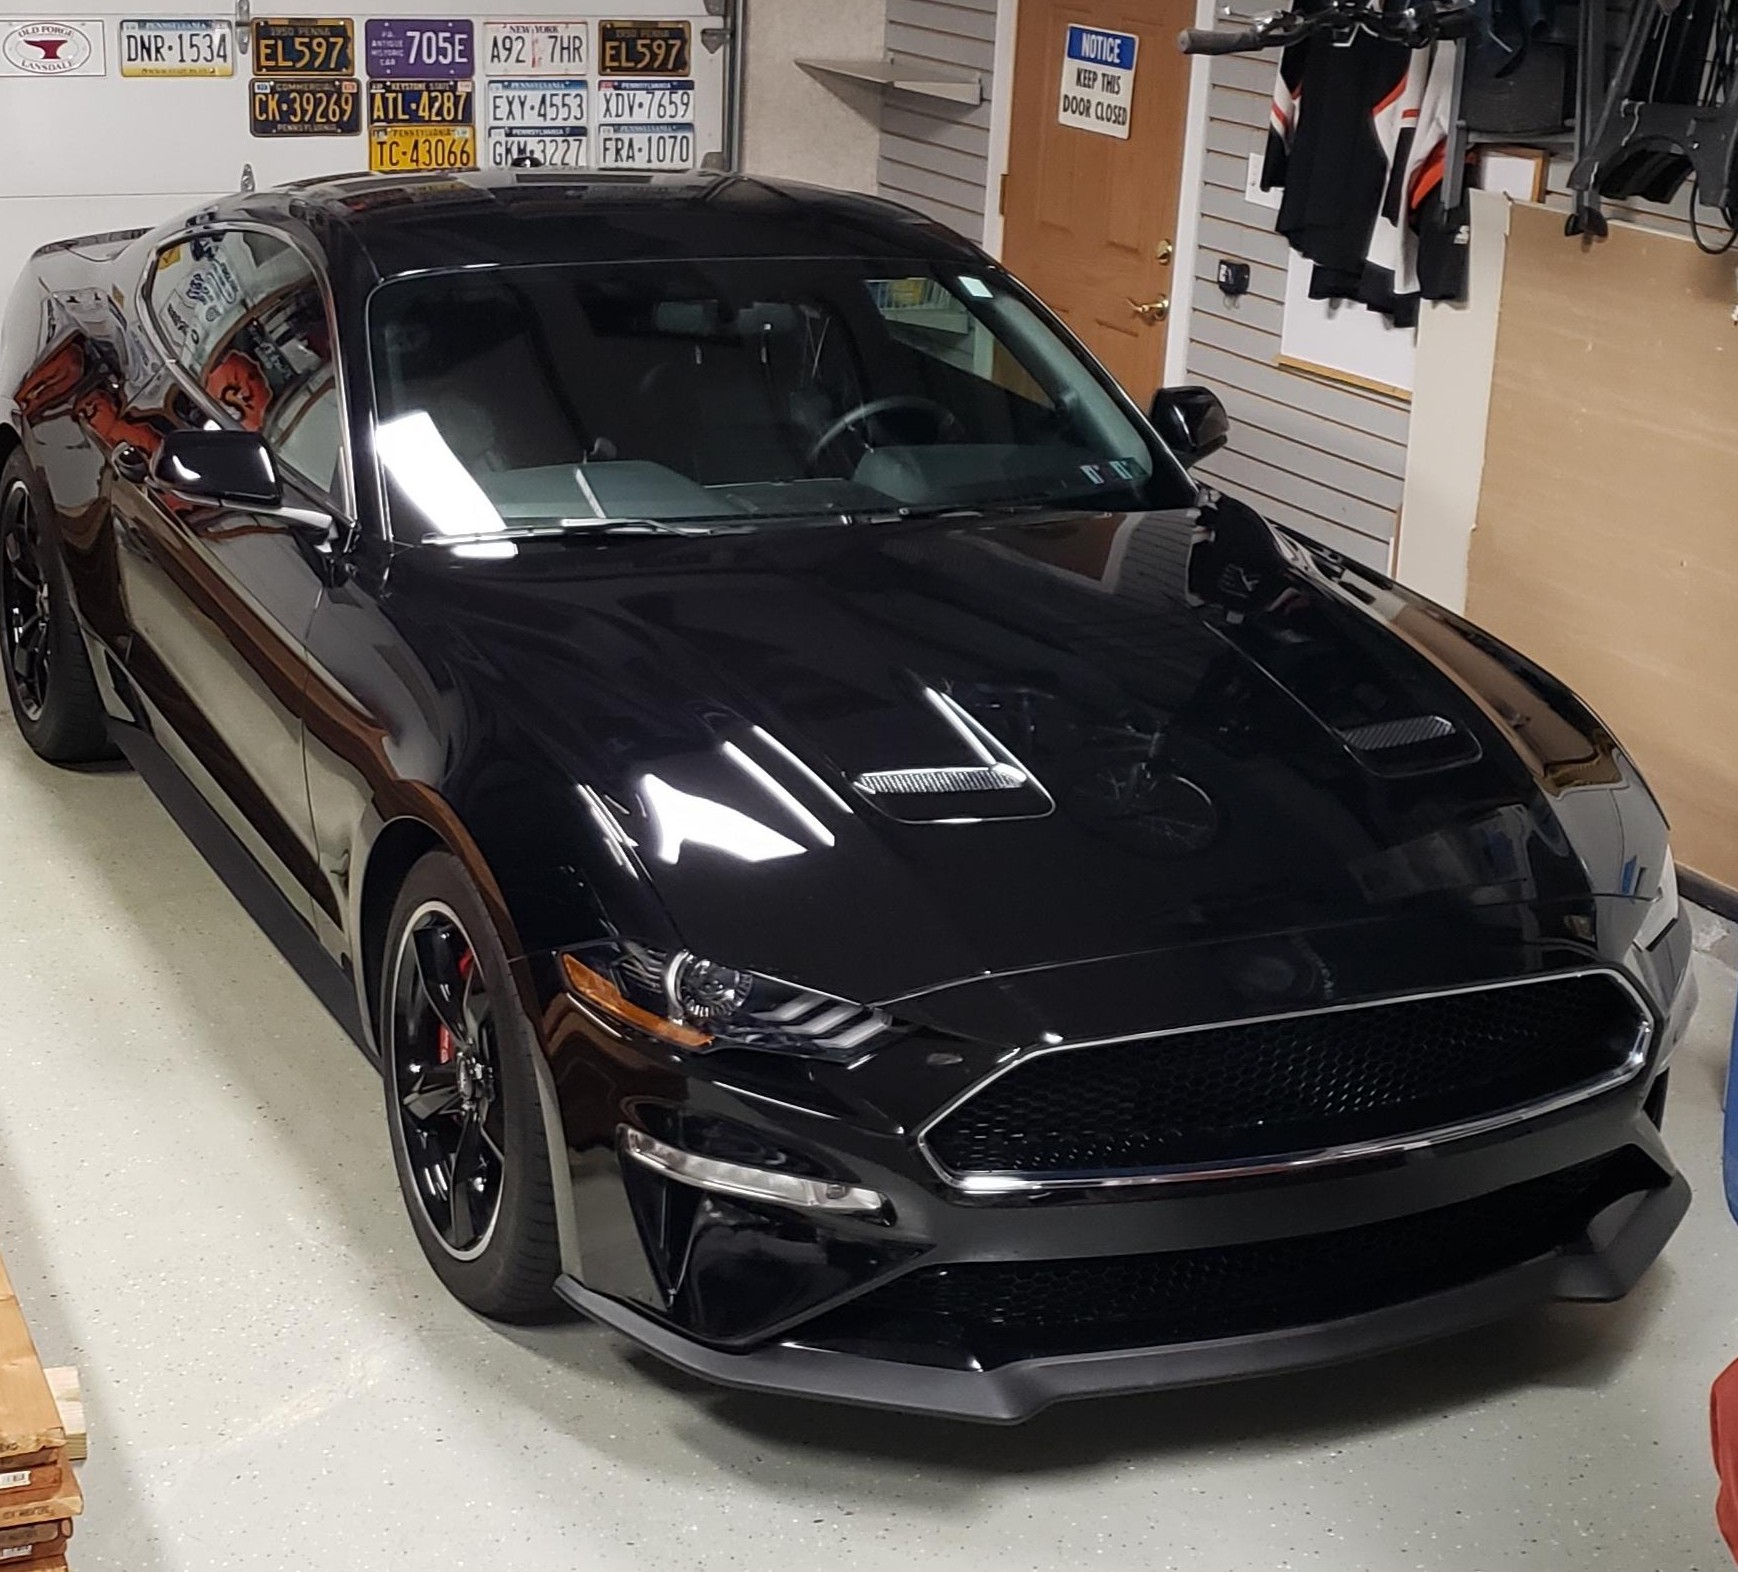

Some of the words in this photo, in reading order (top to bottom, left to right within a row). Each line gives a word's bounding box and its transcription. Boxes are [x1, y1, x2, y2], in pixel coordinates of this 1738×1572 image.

[18, 26, 39, 37] OLD
[509, 25, 530, 34] NEW
[534, 25, 559, 34] YORK
[260, 37, 344, 69] EL597
[406, 31, 468, 64] 705E
[490, 35, 526, 63] A92
[548, 35, 583, 63] 7HR
[604, 39, 681, 69] EL597
[1081, 32, 1122, 63] NOTICE
[1075, 67, 1098, 89] KEEP
[1101, 72, 1122, 95] THIS
[1062, 94, 1092, 118] DOOR
[1095, 101, 1128, 126] CLOSED
